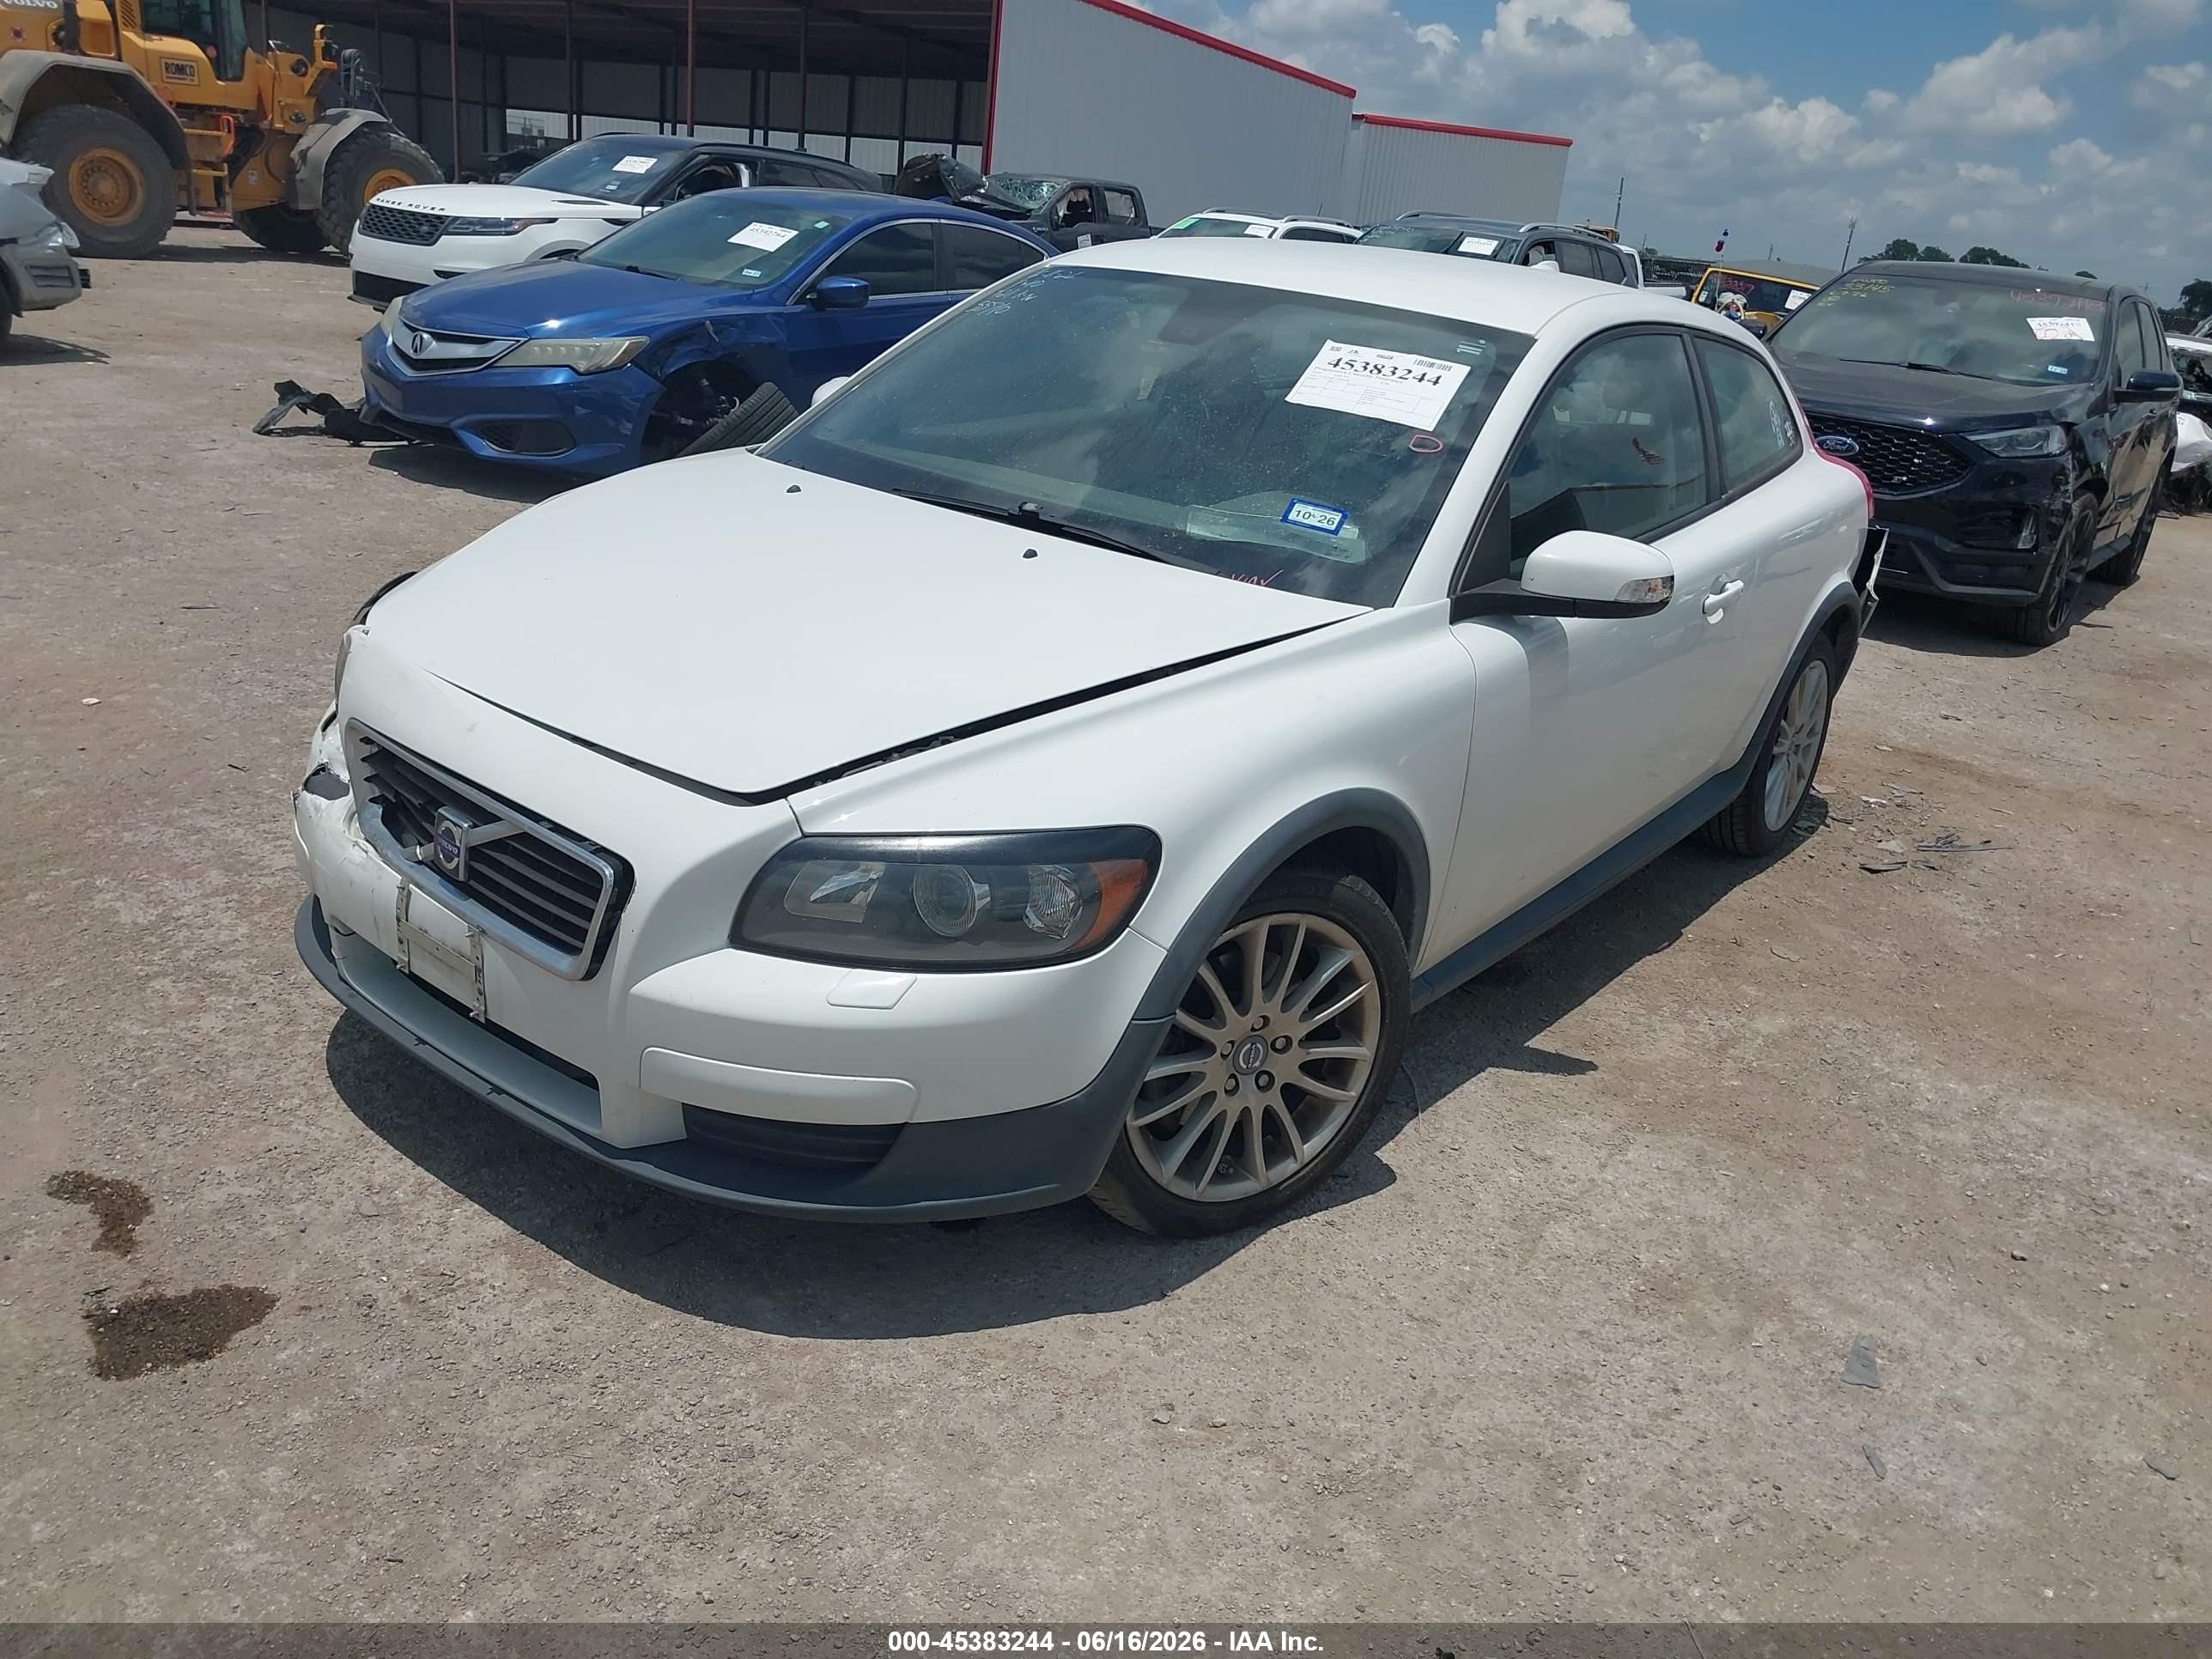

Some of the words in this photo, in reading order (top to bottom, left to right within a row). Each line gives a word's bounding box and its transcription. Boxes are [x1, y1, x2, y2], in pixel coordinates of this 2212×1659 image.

[164, 62, 195, 77] ROMCO
[407, 203, 446, 211] ROVER
[1327, 356, 1443, 386] 45383244
[1823, 439, 1849, 450] Ford
